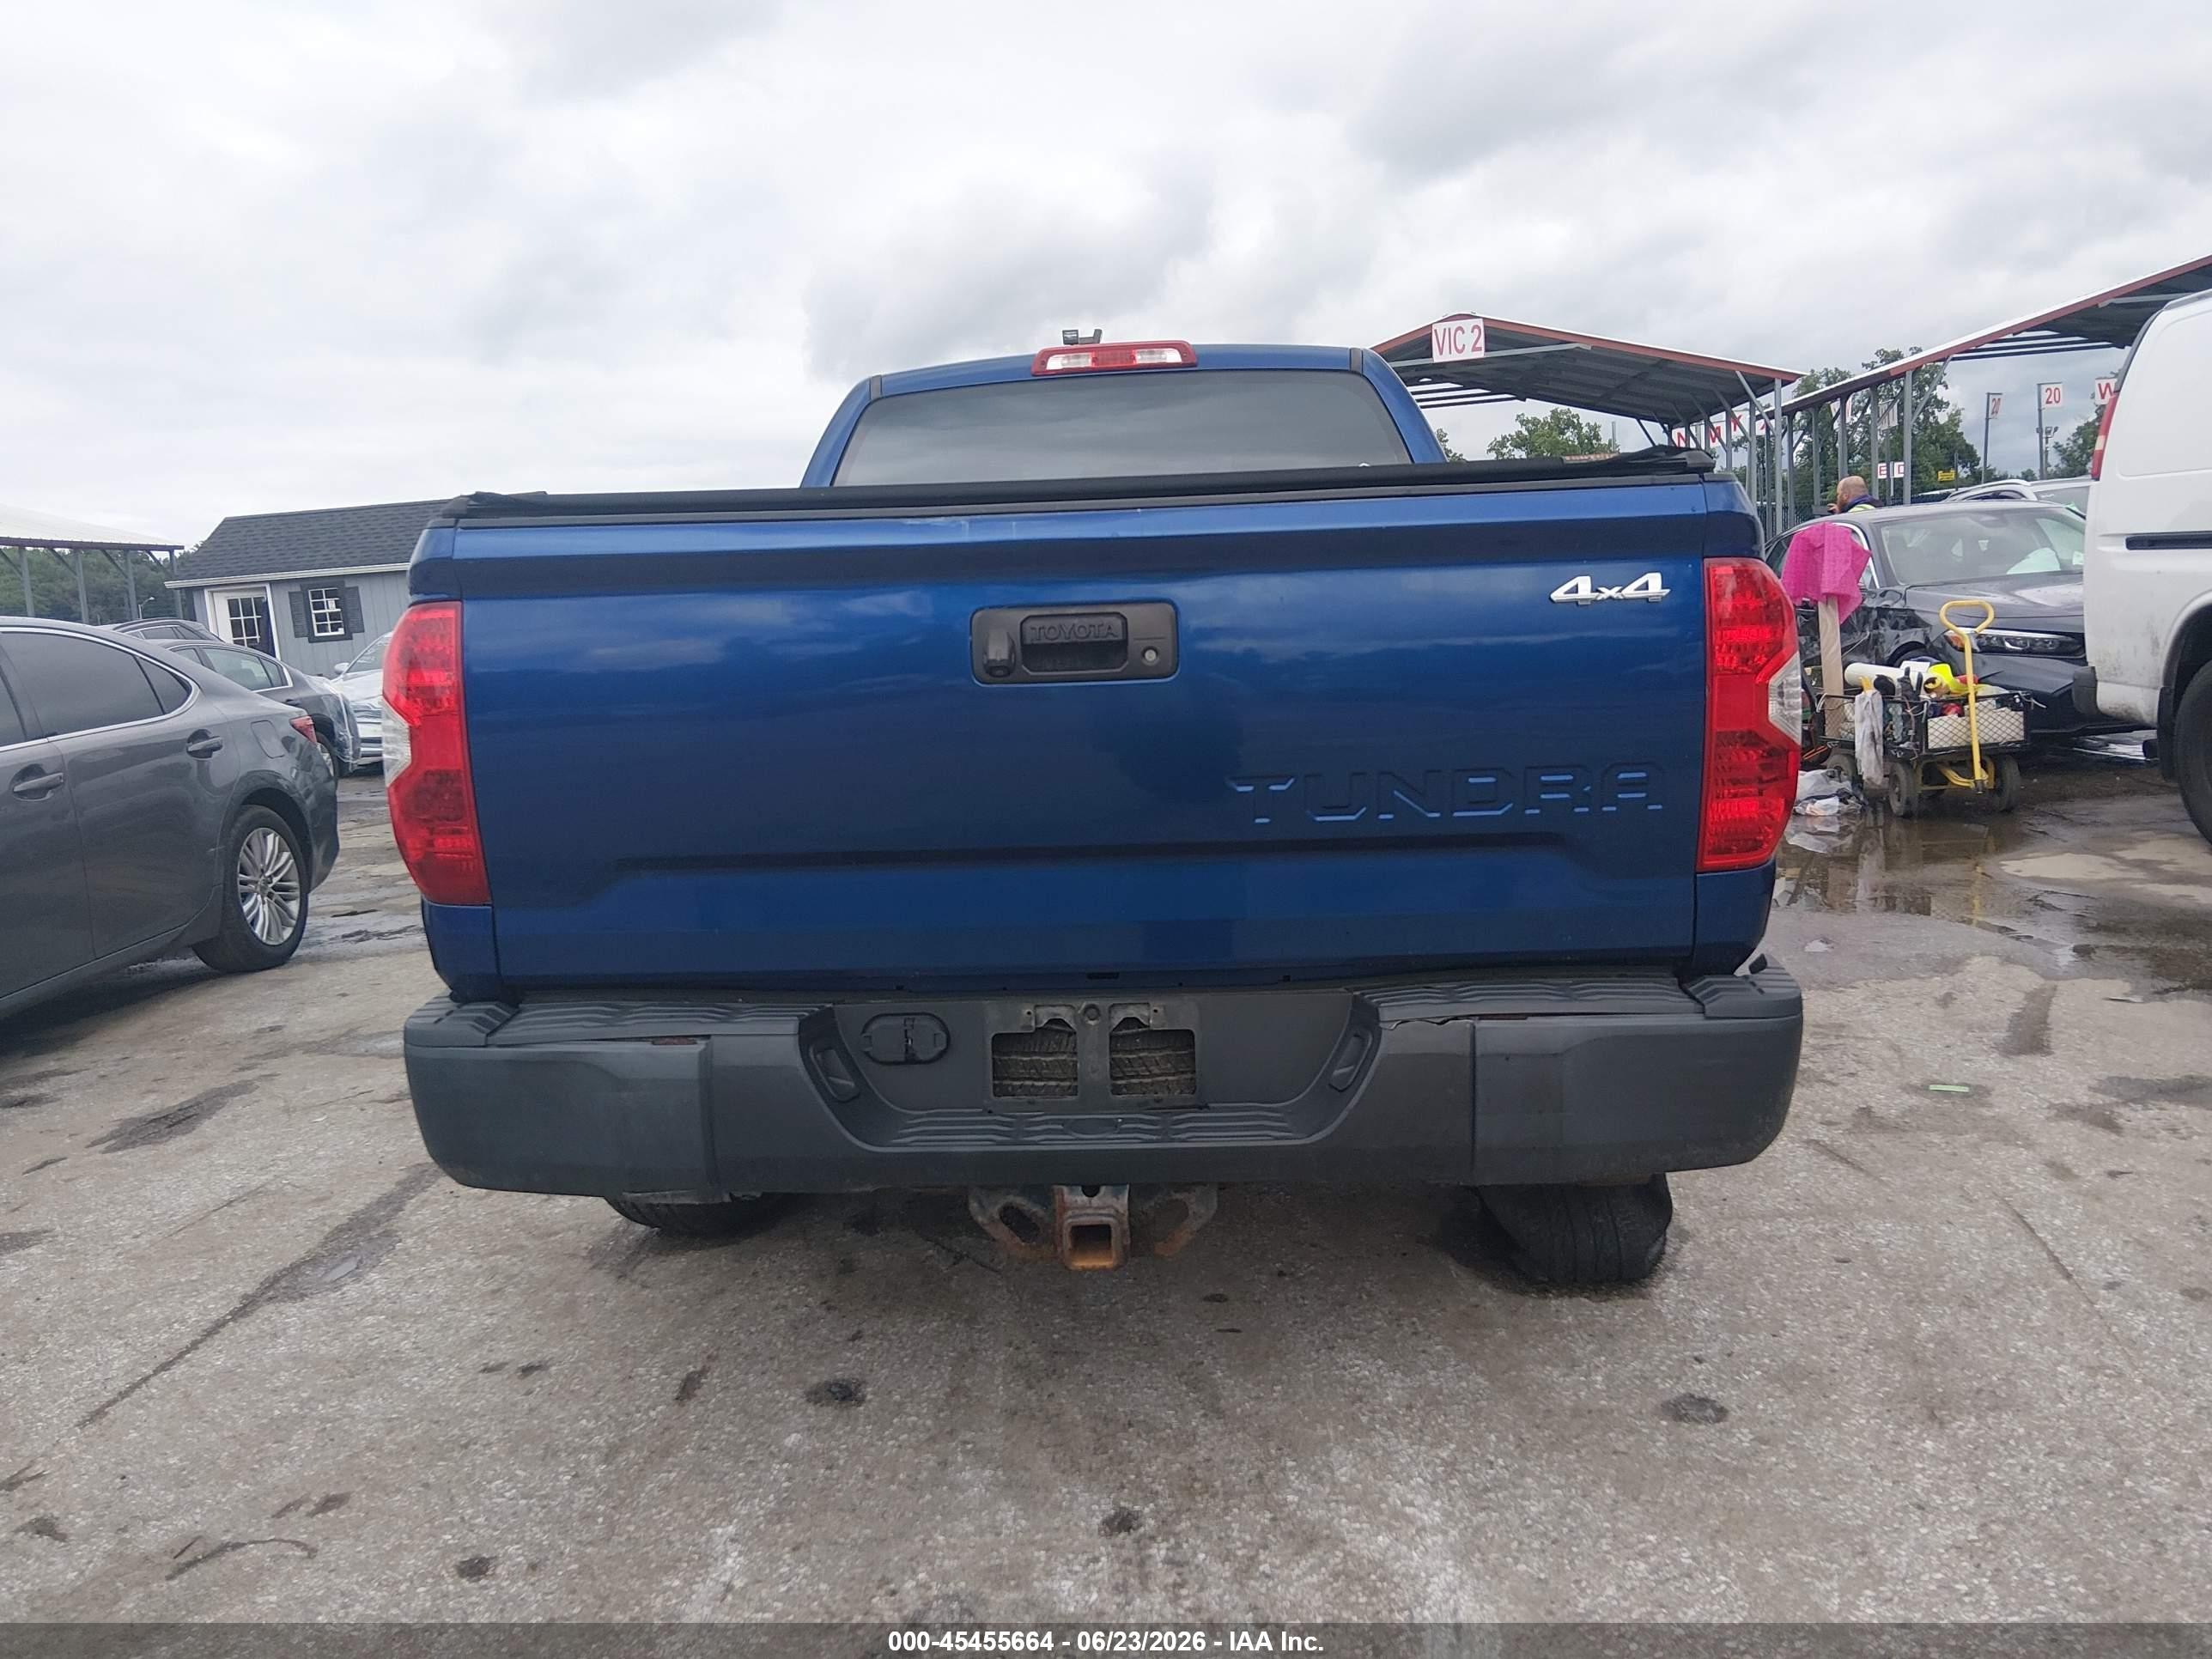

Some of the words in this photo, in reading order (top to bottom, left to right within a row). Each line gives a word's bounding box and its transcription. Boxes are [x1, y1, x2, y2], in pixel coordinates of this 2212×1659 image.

[1434, 325, 1465, 356] VIC
[1471, 325, 1482, 352] 2
[2045, 387, 2061, 404] 20
[1550, 571, 1671, 605] 4x4
[1030, 623, 1119, 641] TOYOTA
[1226, 762, 1665, 823] TUNDRA
